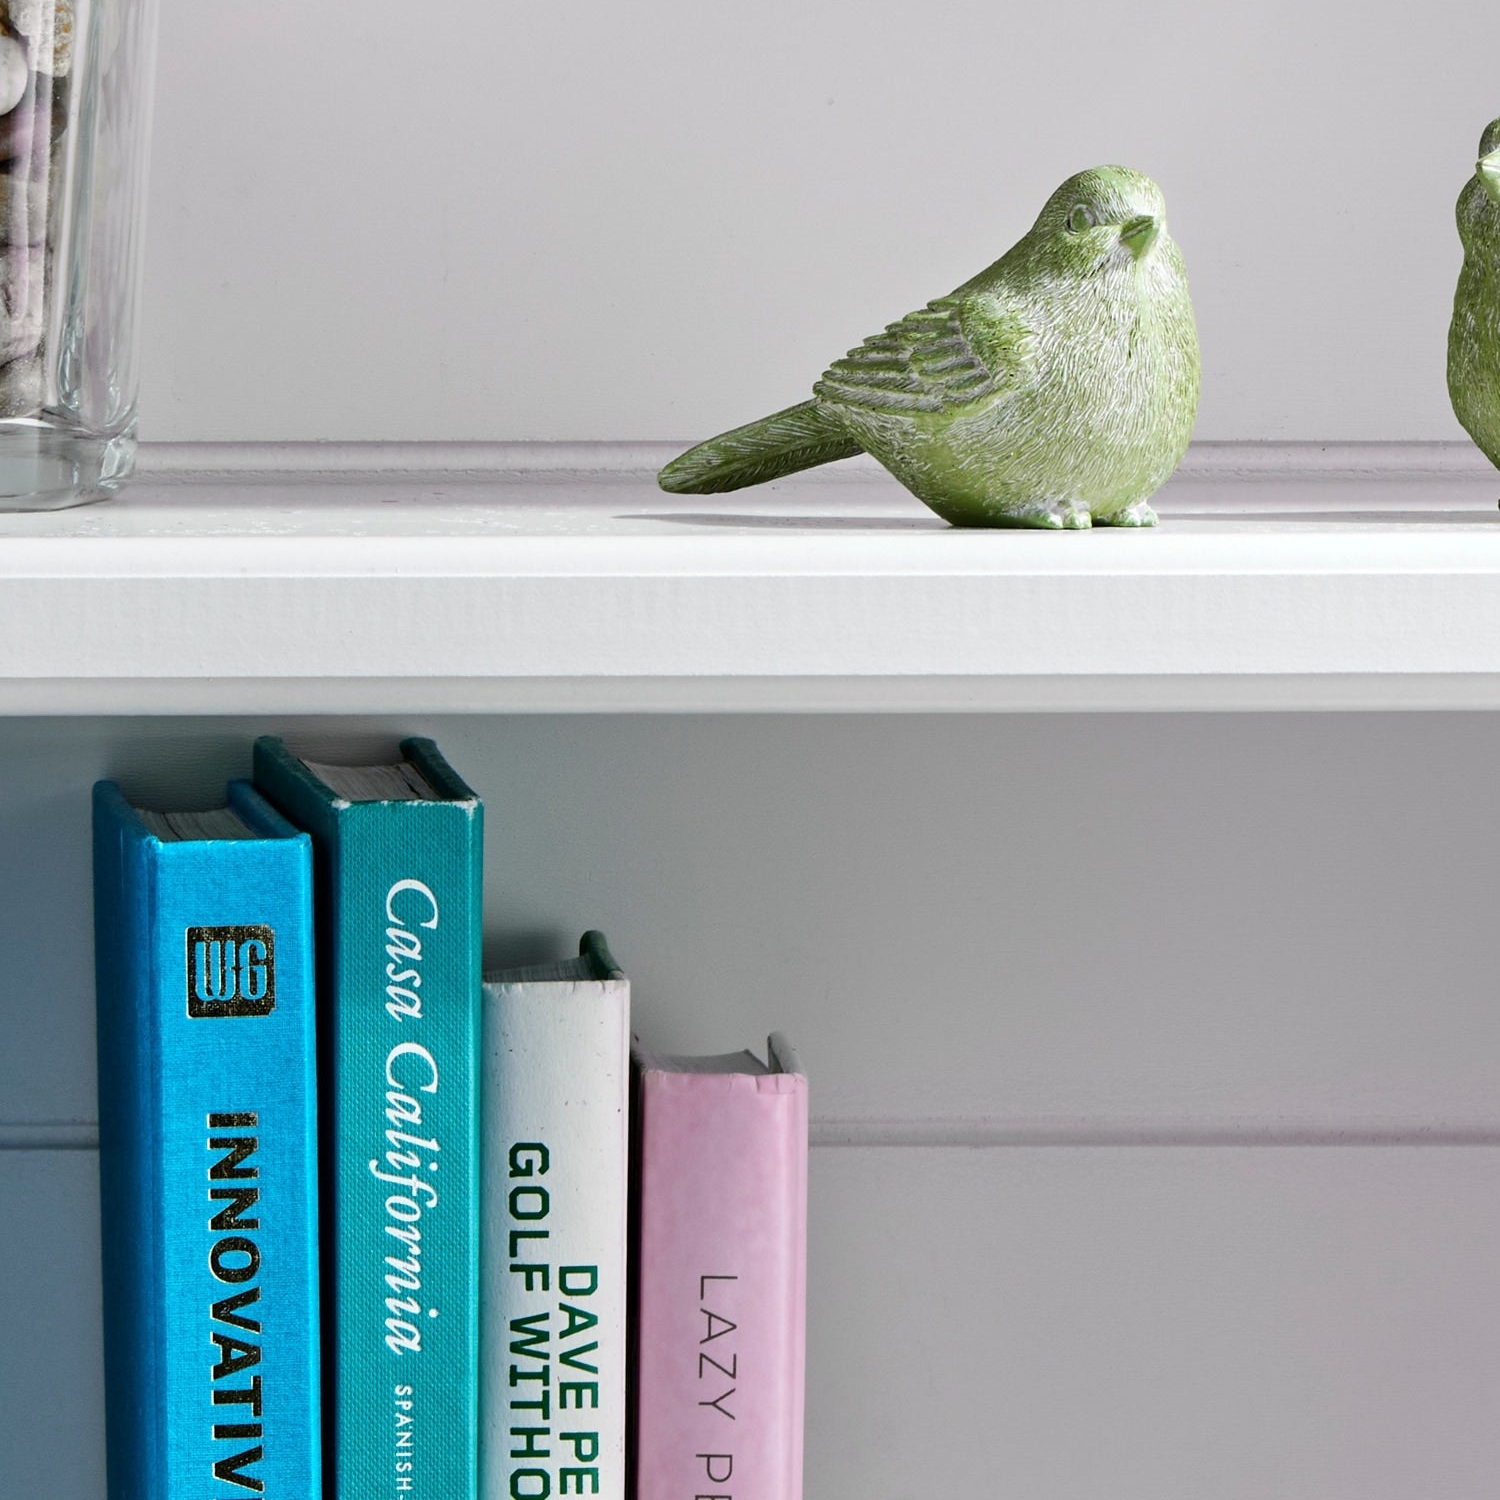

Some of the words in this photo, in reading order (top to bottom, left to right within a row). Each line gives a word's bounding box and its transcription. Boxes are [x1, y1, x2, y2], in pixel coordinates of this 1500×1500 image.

[195, 939, 267, 1001] WG
[385, 878, 439, 1023] Casa
[368, 1041, 440, 1356] California
[508, 1142, 550, 1292] GOLF
[209, 1112, 263, 1500] INNOVATIV
[558, 1265, 599, 1410] DAVE
[697, 1275, 738, 1421] LAZY
[509, 1312, 551, 1500] WITHO
[559, 1431, 599, 1495] PE
[694, 1453, 733, 1500] P
